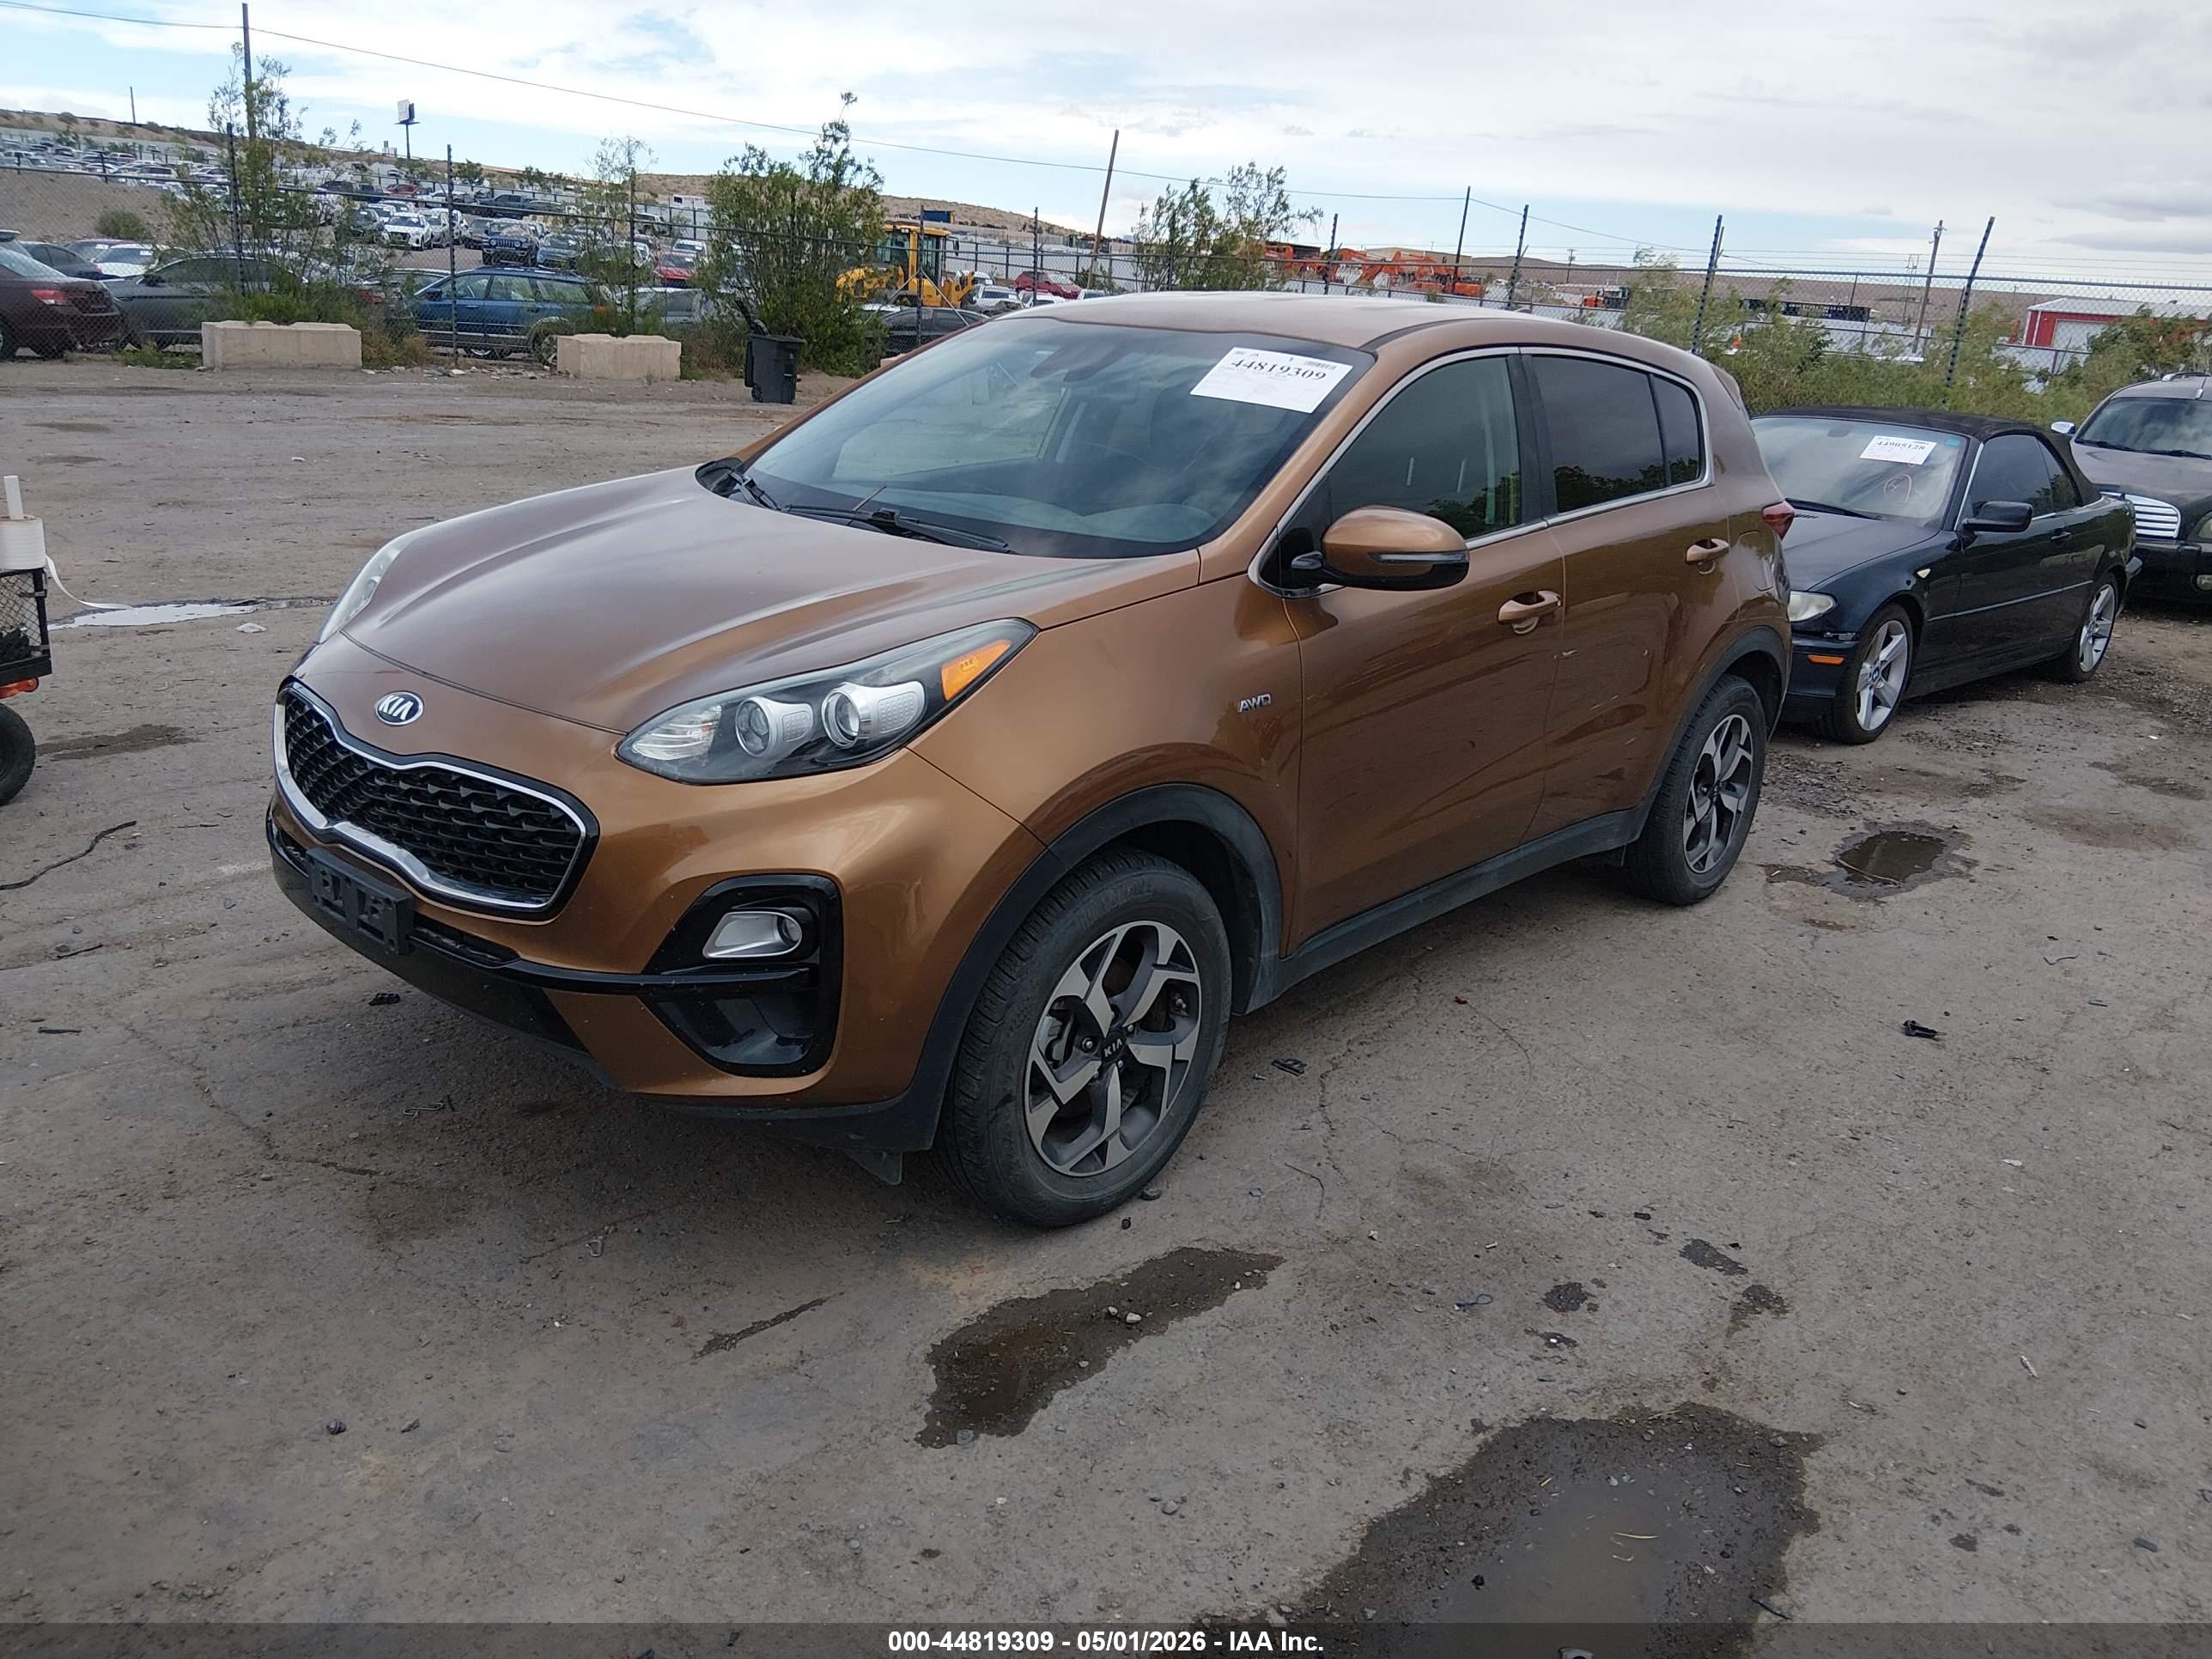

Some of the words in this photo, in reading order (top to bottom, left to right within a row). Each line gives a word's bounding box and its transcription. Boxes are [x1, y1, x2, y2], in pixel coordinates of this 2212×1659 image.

[1231, 358, 1328, 380] 44819309
[378, 695, 415, 720] KIA
[1237, 693, 1272, 714] AWD
[1103, 1037, 1124, 1058] KIA
